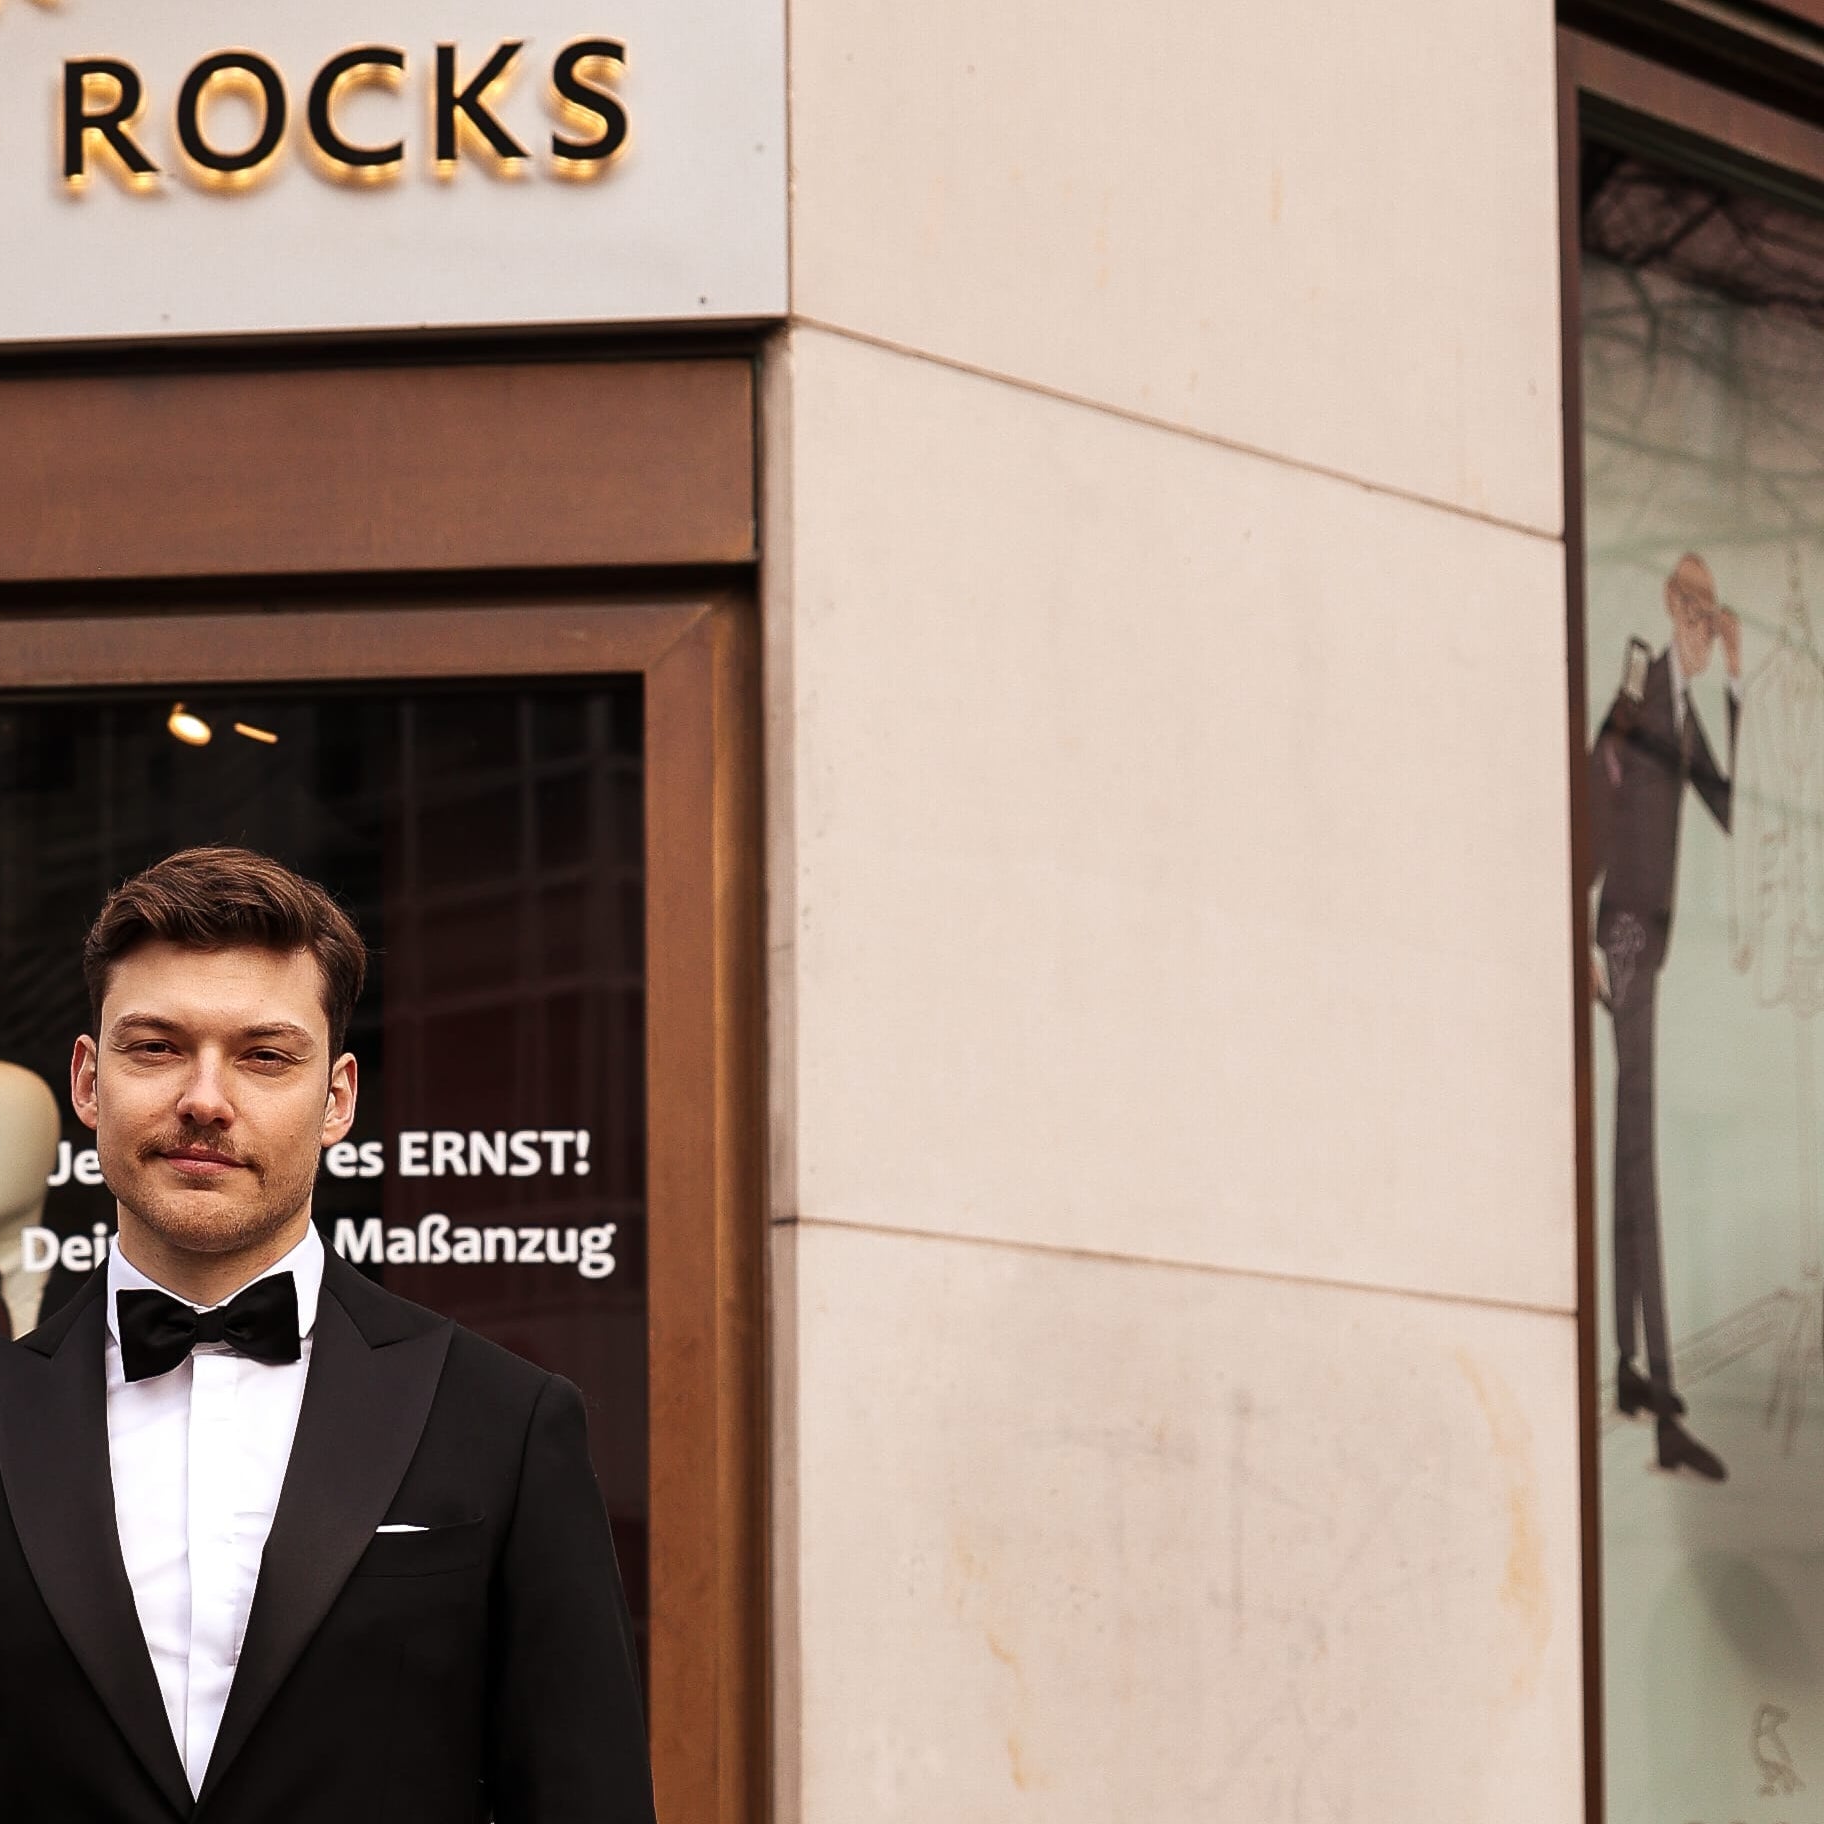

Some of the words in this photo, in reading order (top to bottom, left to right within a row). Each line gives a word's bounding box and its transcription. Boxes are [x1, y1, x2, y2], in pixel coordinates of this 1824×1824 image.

[62, 39, 629, 178] ROCKS
[46, 1140, 104, 1187] Je
[326, 1140, 385, 1178] es
[398, 1129, 591, 1178] ERNST!
[20, 1222, 112, 1273] Dei
[332, 1212, 617, 1279] Maßanzug
